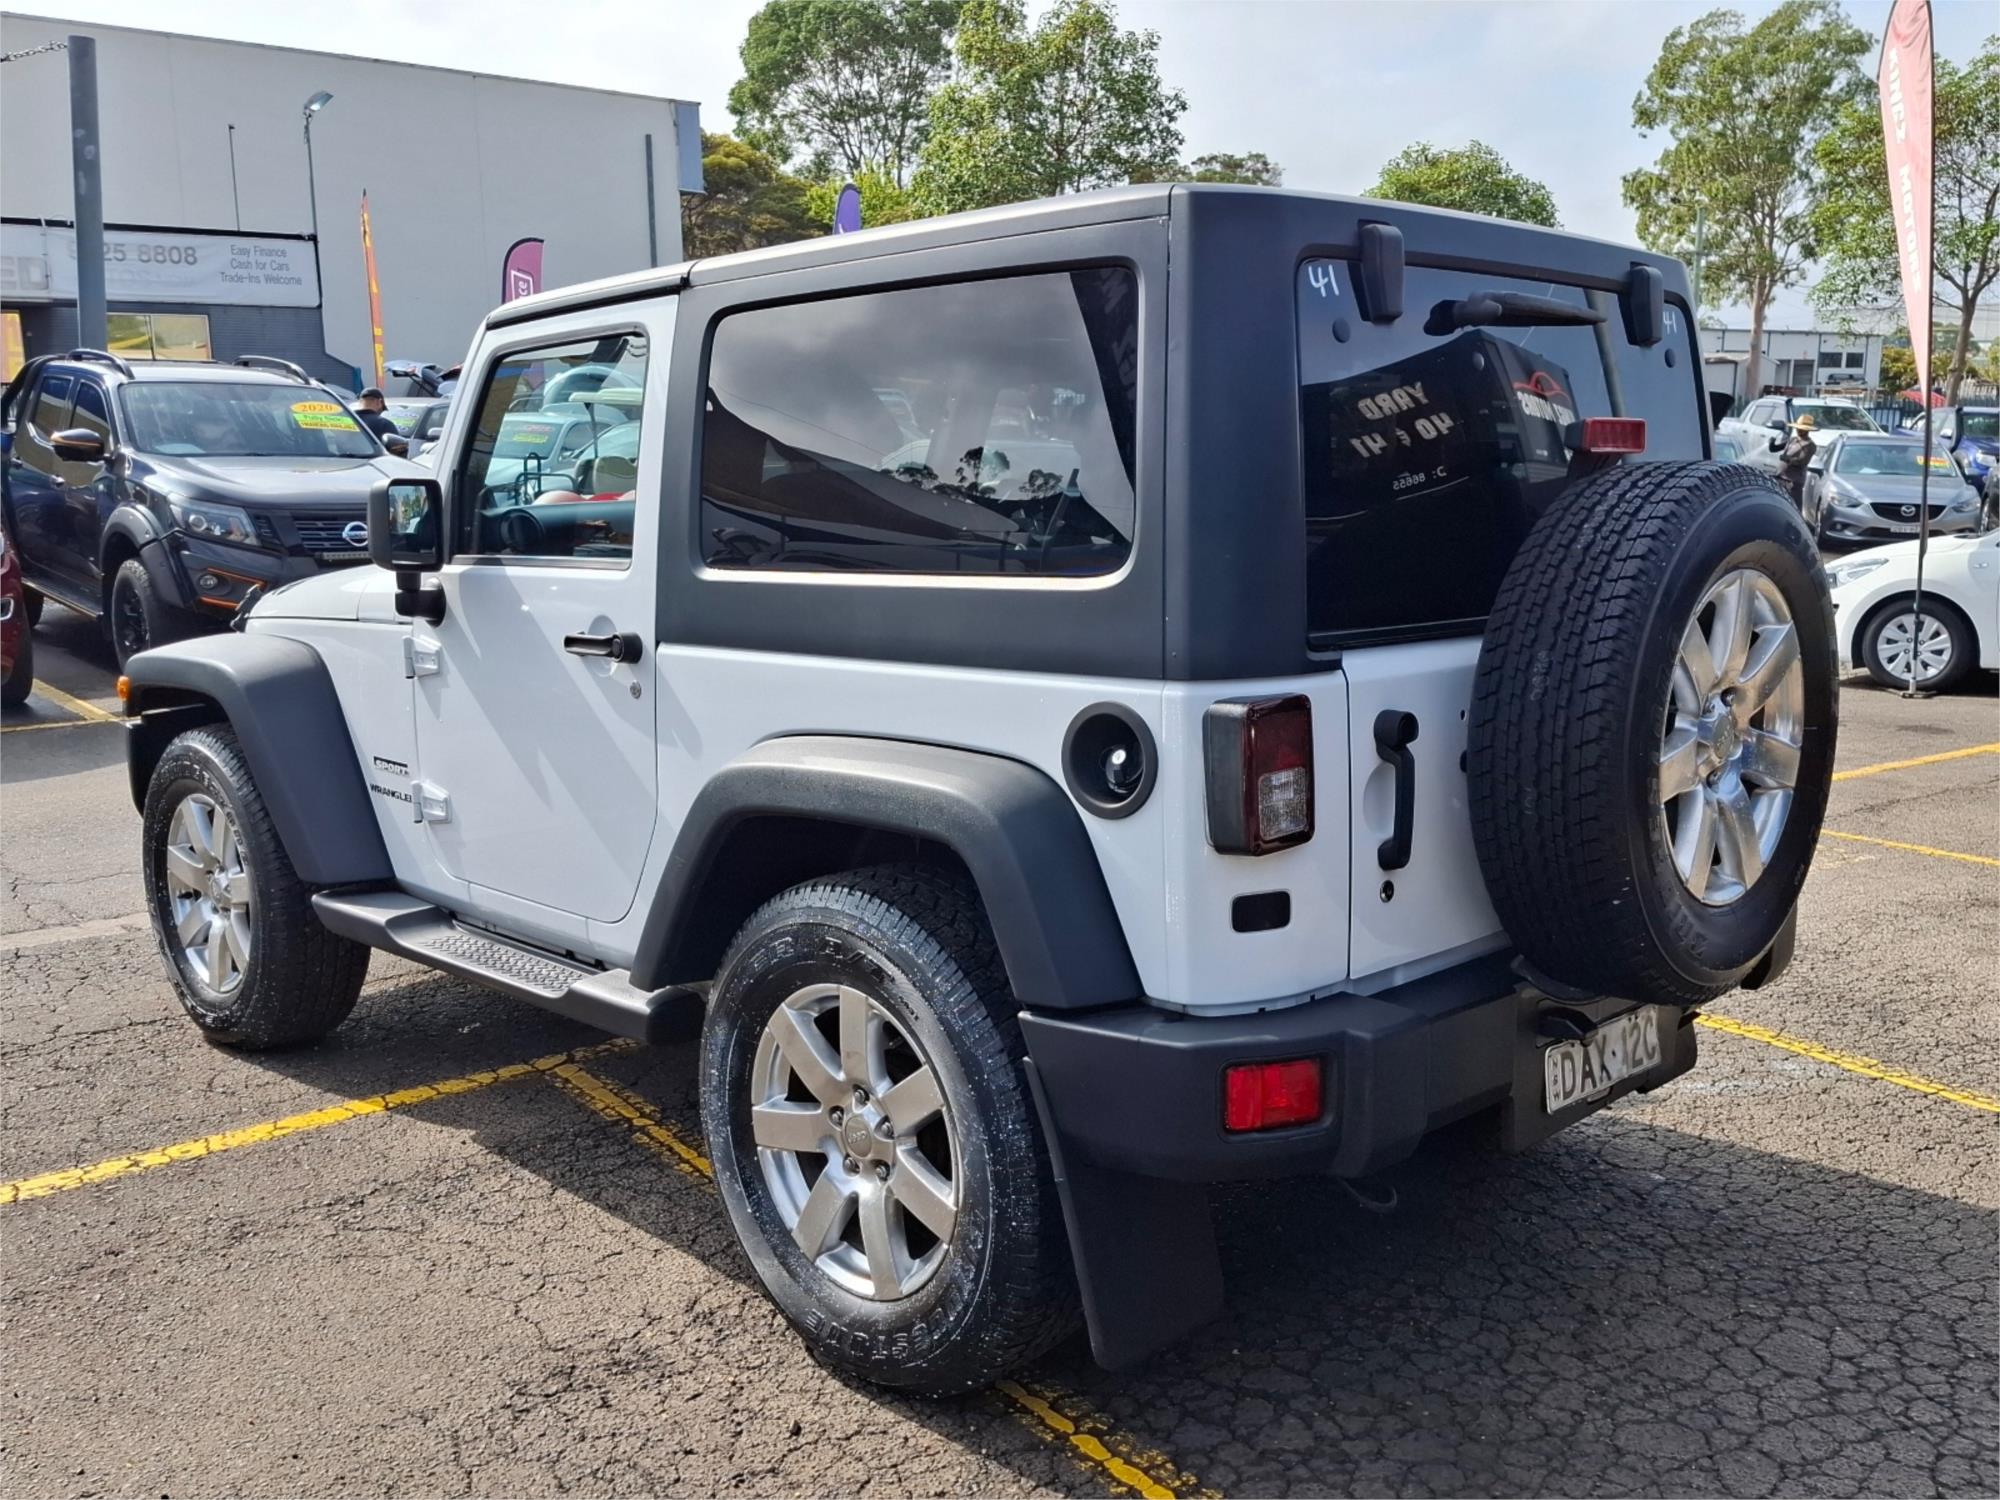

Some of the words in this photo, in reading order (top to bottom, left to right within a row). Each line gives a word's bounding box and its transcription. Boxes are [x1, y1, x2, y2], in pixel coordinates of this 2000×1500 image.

[1899, 162, 1921, 293] MOTORS
[138, 244, 198, 266] 8808
[230, 244, 251, 258] Easy
[253, 245, 288, 258] Finance
[231, 258, 252, 270] Cash
[255, 260, 266, 271] for
[270, 260, 290, 272] Cars
[264, 273, 303, 286] Welcome
[1308, 264, 1340, 297] 41
[301, 403, 333, 412] 2020
[373, 756, 410, 776] SPORT
